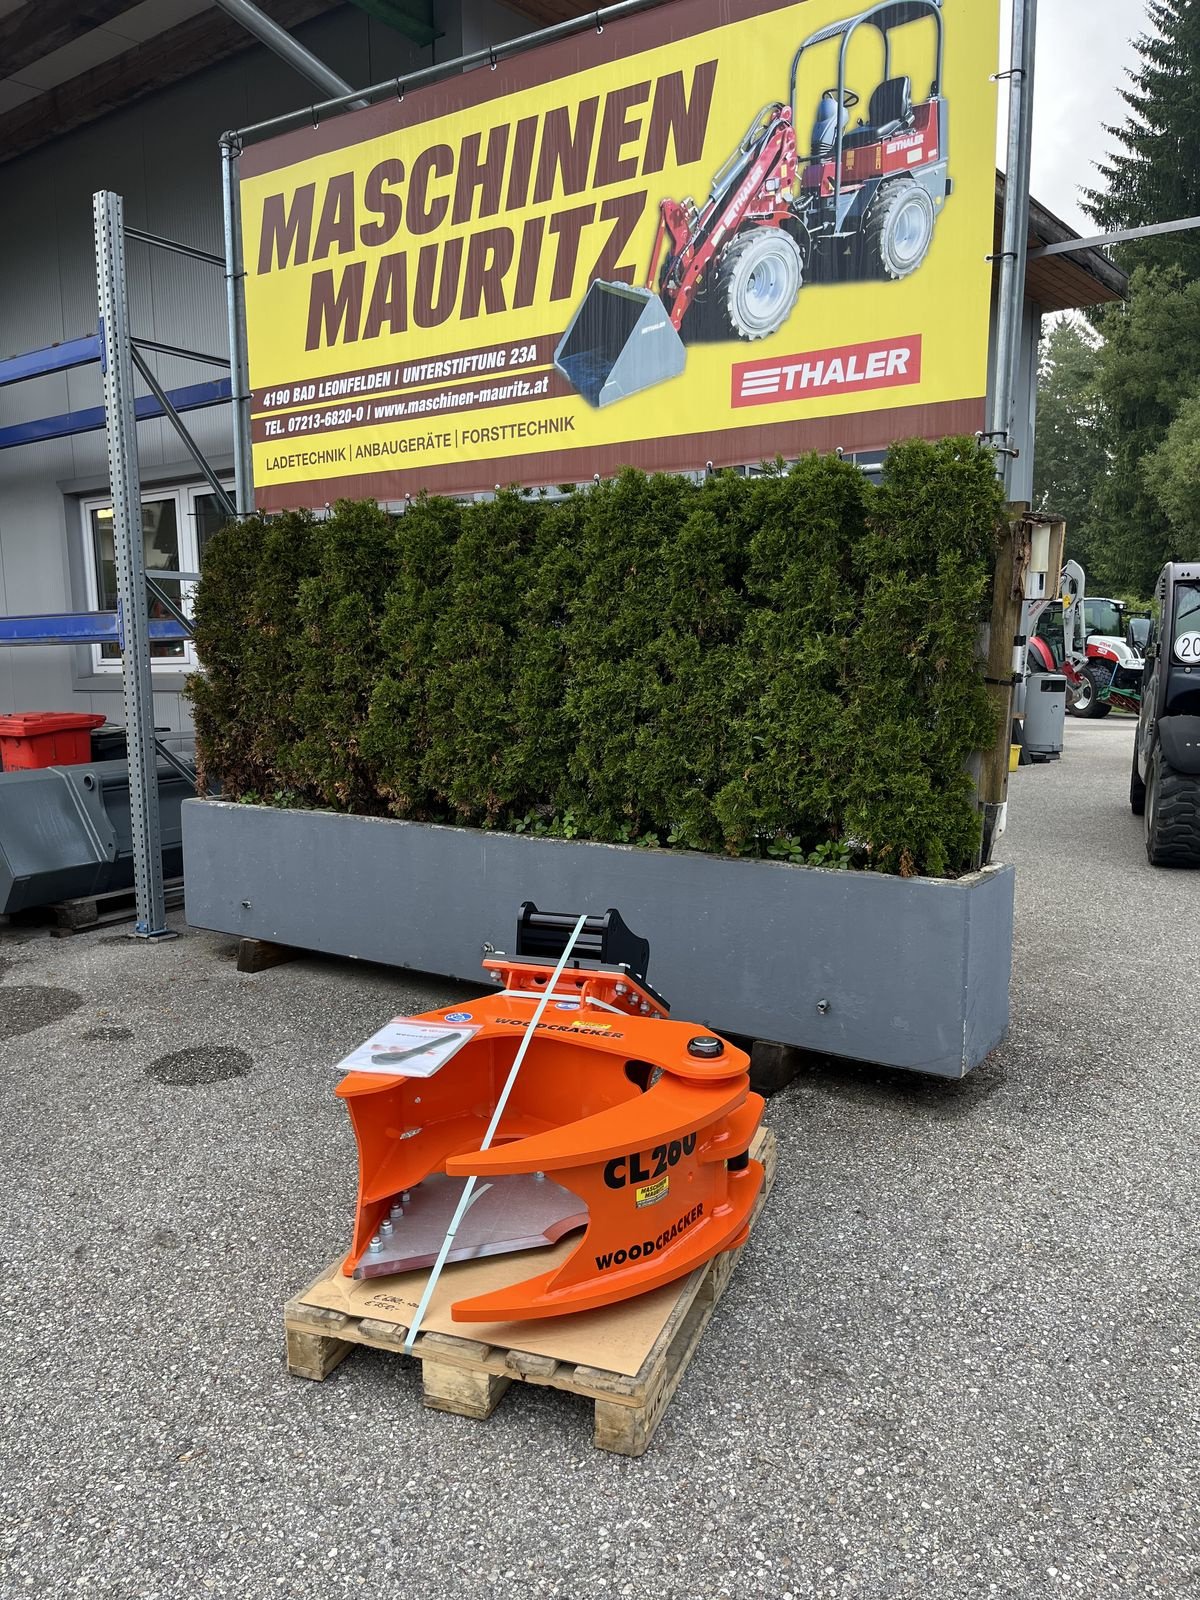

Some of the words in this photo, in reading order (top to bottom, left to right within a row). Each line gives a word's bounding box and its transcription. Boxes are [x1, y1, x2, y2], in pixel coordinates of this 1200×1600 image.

[257, 58, 718, 275] MASCHINEN
[305, 190, 647, 352] MAURITZ
[263, 389, 290, 407] 4190
[293, 385, 316, 402] BAD
[318, 371, 391, 398] LEONFELDEN
[402, 350, 506, 384] UNTERSTIFTUNG
[509, 344, 537, 365] 23A
[781, 348, 911, 391] THALER
[265, 421, 285, 436] TEL.
[288, 407, 364, 432] 07213-6820-0
[374, 376, 549, 419] www.maschinen-mauritz.at
[266, 447, 346, 471] LADETECHNIK
[355, 432, 452, 459] ANBAUGERÄTE
[462, 415, 575, 445] FORSTTECHNIK
[1181, 637, 1200, 657] 20
[495, 1017, 624, 1039] WOODCRACKER
[594, 1202, 704, 1271] WOODCRACKER
